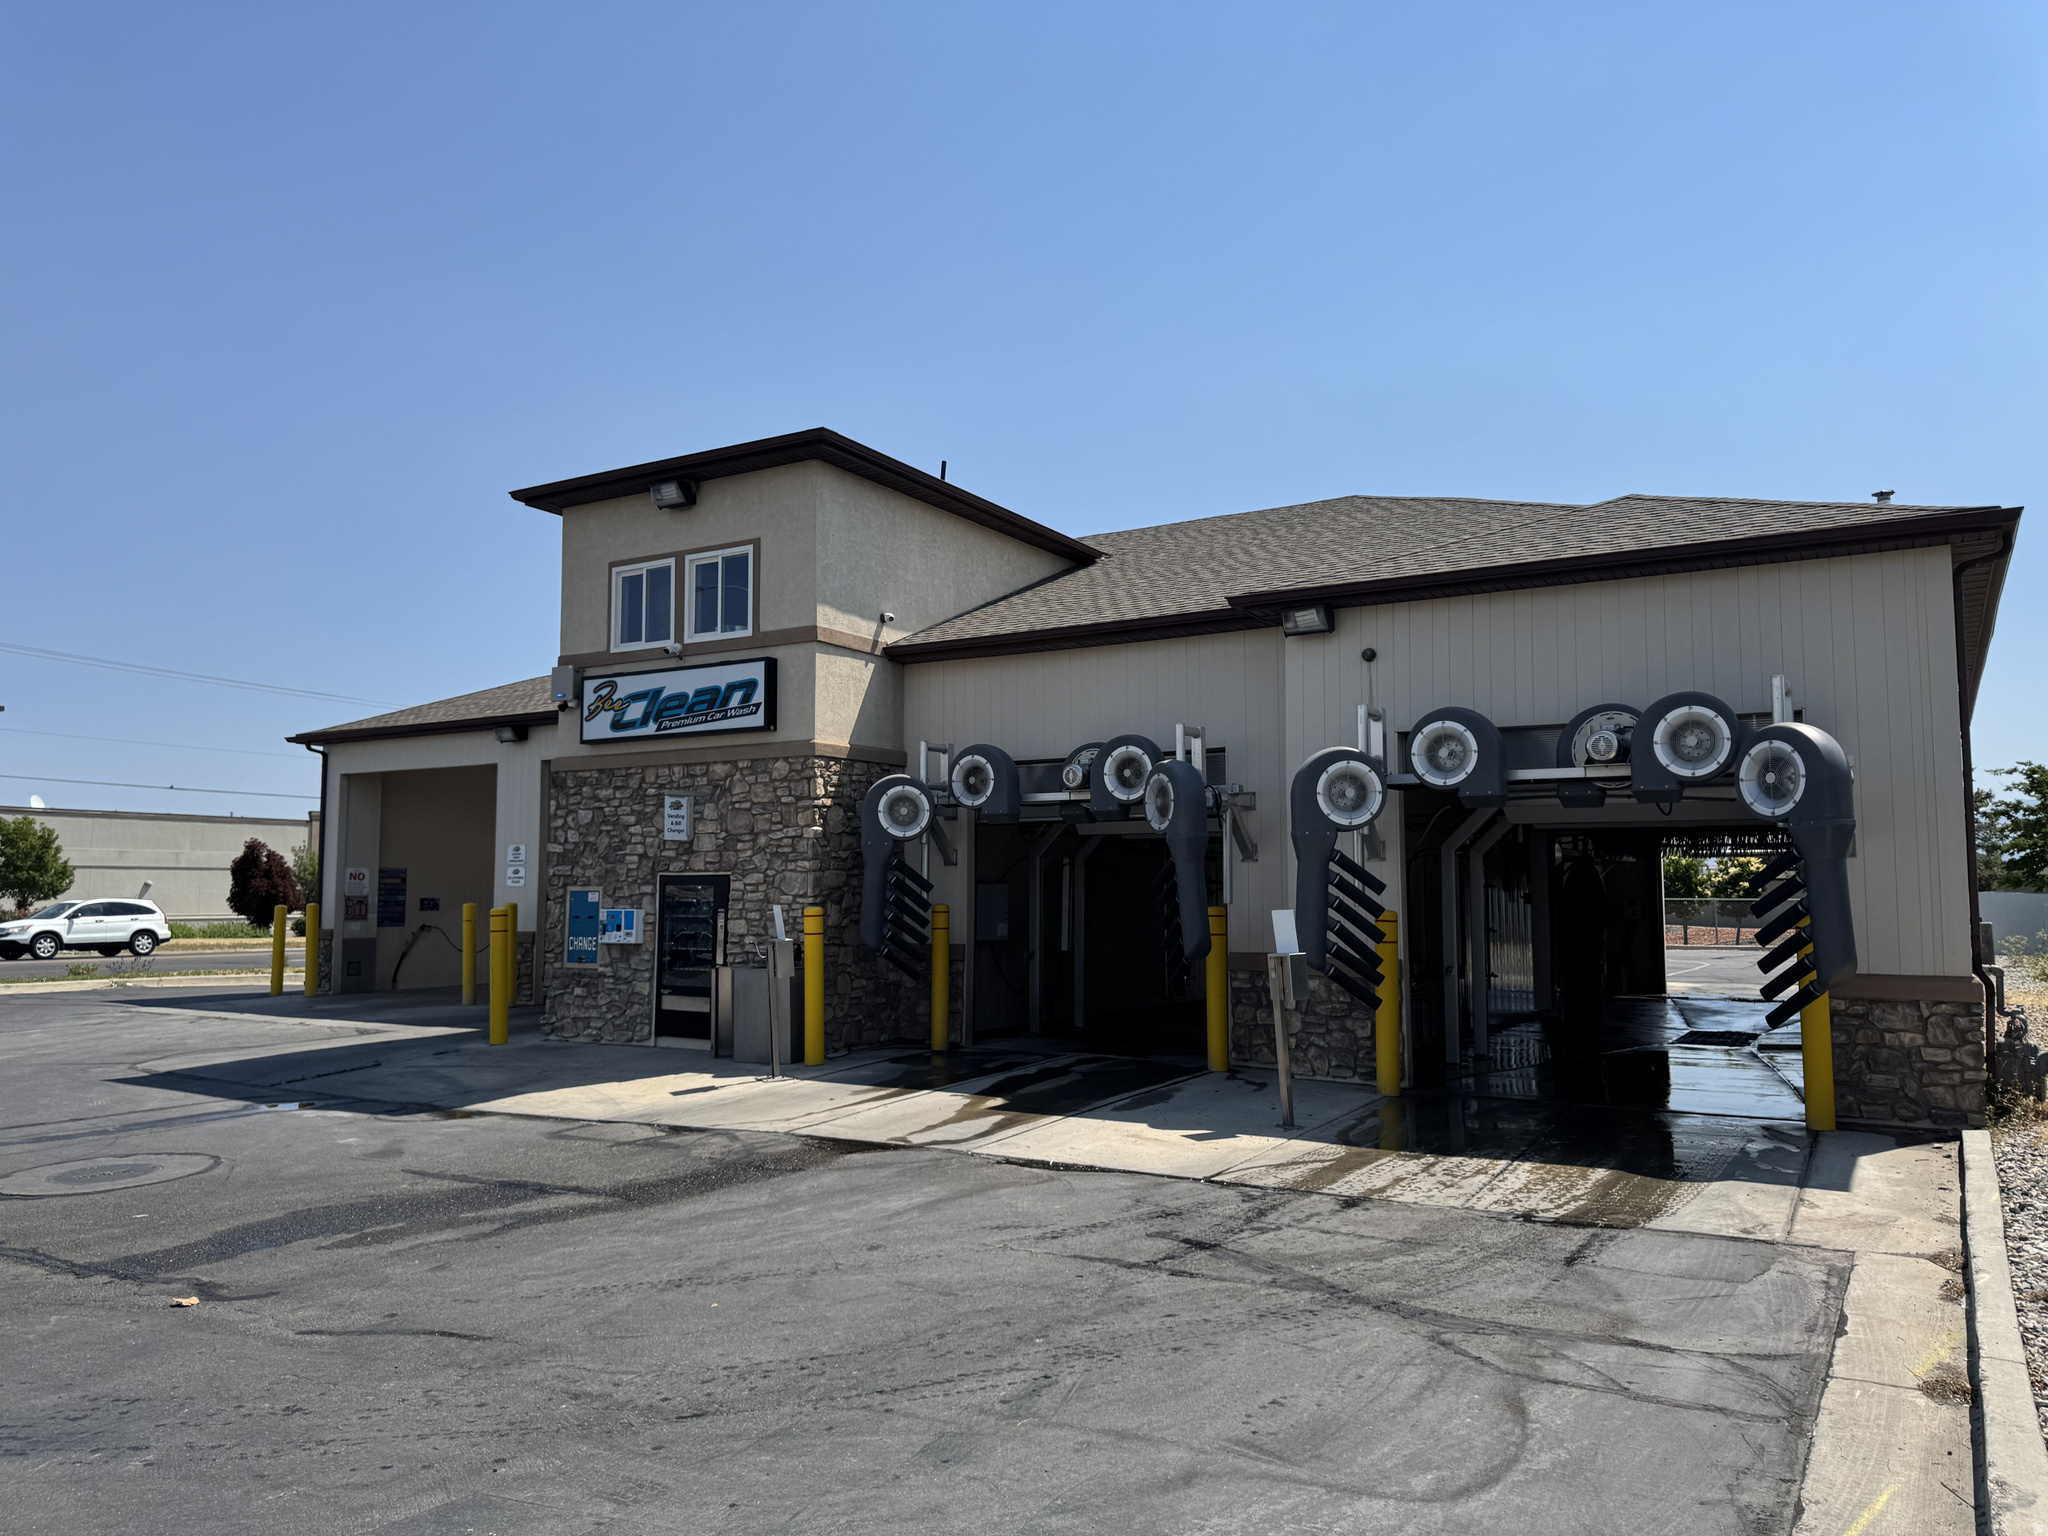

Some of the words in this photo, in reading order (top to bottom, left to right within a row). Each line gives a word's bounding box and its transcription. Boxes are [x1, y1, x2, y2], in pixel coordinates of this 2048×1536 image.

[585, 680, 631, 721] Bee
[610, 678, 759, 732] Clean
[661, 716, 706, 729] Premium
[707, 711, 723, 721] Car
[727, 706, 757, 717] Wash
[349, 872, 365, 881] NO
[569, 937, 597, 950] CHANGE
